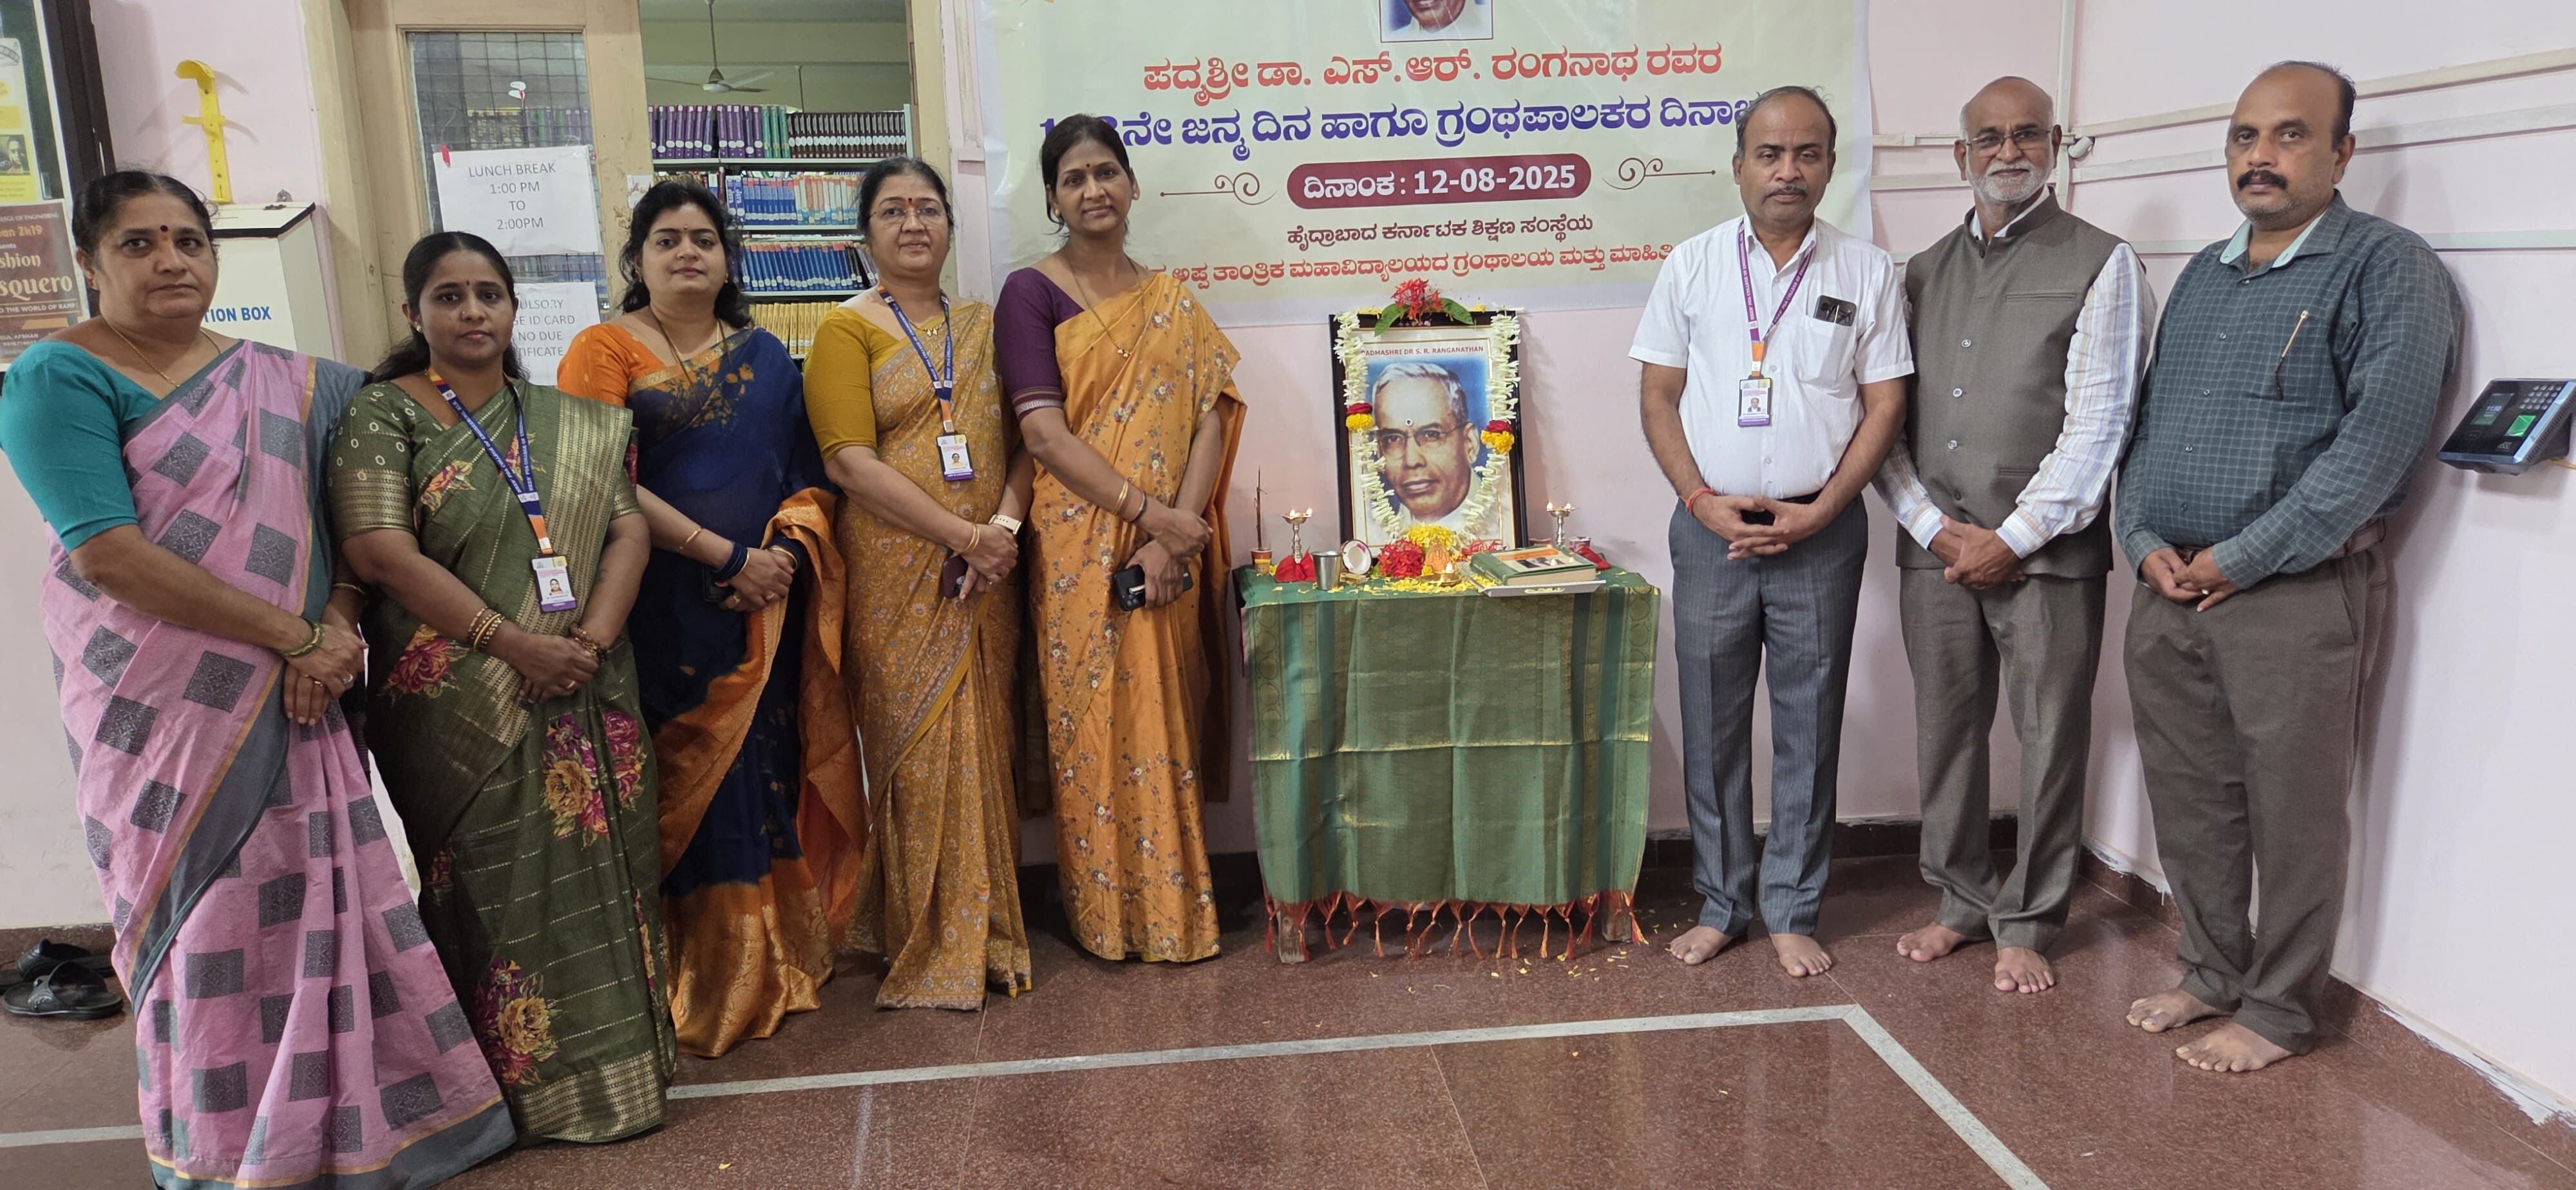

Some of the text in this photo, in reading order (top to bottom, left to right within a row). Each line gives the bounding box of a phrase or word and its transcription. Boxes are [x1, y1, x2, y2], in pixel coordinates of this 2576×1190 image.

[1144, 57, 1249, 106] ಪದ್ಮಶ್ರೀ
[1257, 62, 1311, 86] ಡಾ.
[1646, 42, 1722, 75] ರವರ
[1182, 108, 1251, 161] ಜನ್ಮ
[1253, 106, 1311, 142] ದಿನ
[1321, 103, 1428, 139] ಹಾಗೂ
[1435, 95, 1651, 147] ಗ್ರಂಥಪಾಲಕರ
[469, 162, 556, 177] LUNCH BREAK
[1414, 165, 1576, 194] 12-08-2025
[489, 181, 540, 194] 1:00 PM
[509, 200, 526, 211] TO
[497, 217, 544, 230] 2:00PM
[1382, 219, 1467, 240] ಕರ್ನಾಟಕ
[1472, 218, 1515, 242] ಶಿಕ್ಷಣ
[1213, 259, 1284, 286] ತಾಂತ್ರಿಕ
[1452, 247, 1555, 277] ಗ್ರಂಥಾಲಯ
[1559, 245, 1605, 270] ಮತ್ತು
[5, 306, 19, 314] THE
[20, 305, 47, 313] WORLD
[240, 307, 272, 321] BOX
[529, 316, 541, 325] ID
[544, 314, 575, 325] CARD
[518, 330, 564, 341] NO DUE
[1432, 346, 1484, 354] RANGANATHAN
